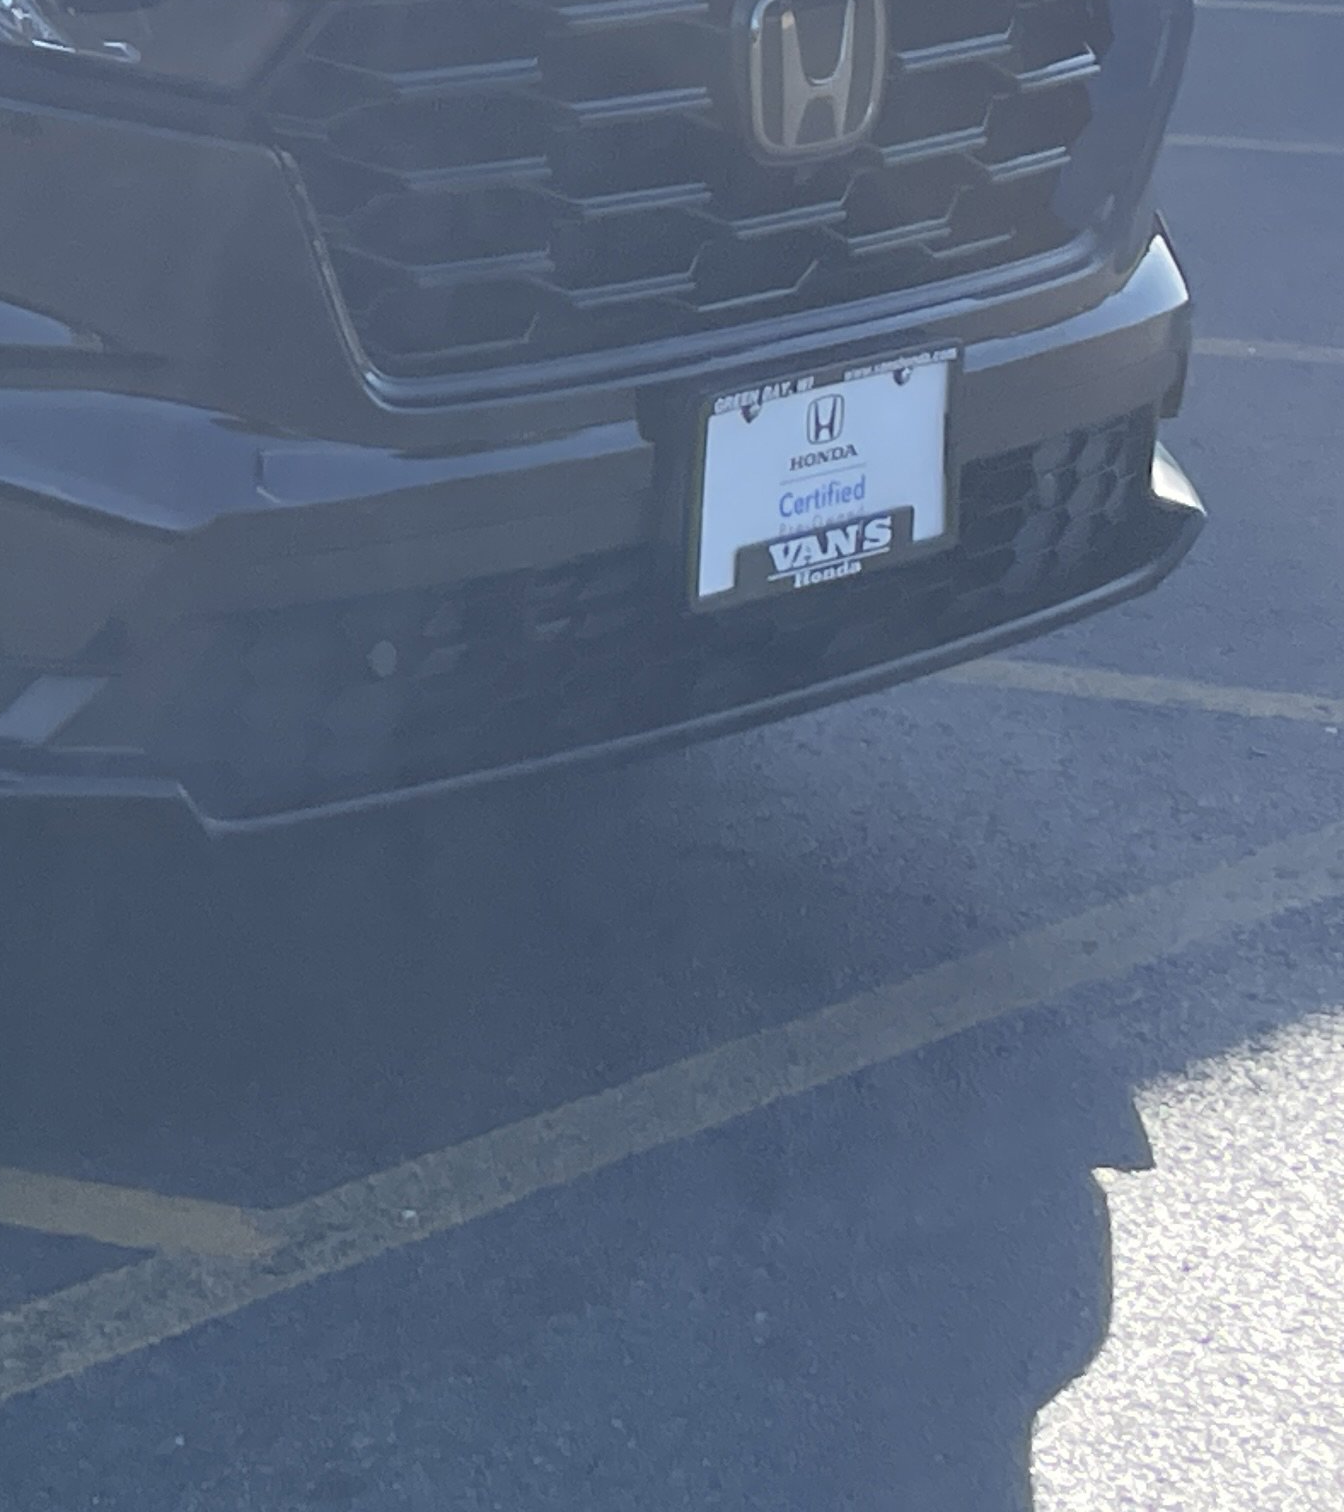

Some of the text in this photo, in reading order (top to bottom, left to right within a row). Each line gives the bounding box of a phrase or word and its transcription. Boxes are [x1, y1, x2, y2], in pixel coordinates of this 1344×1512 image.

[789, 444, 859, 472] HONDA
[779, 474, 866, 518] Certified
[794, 561, 862, 588] Honda
